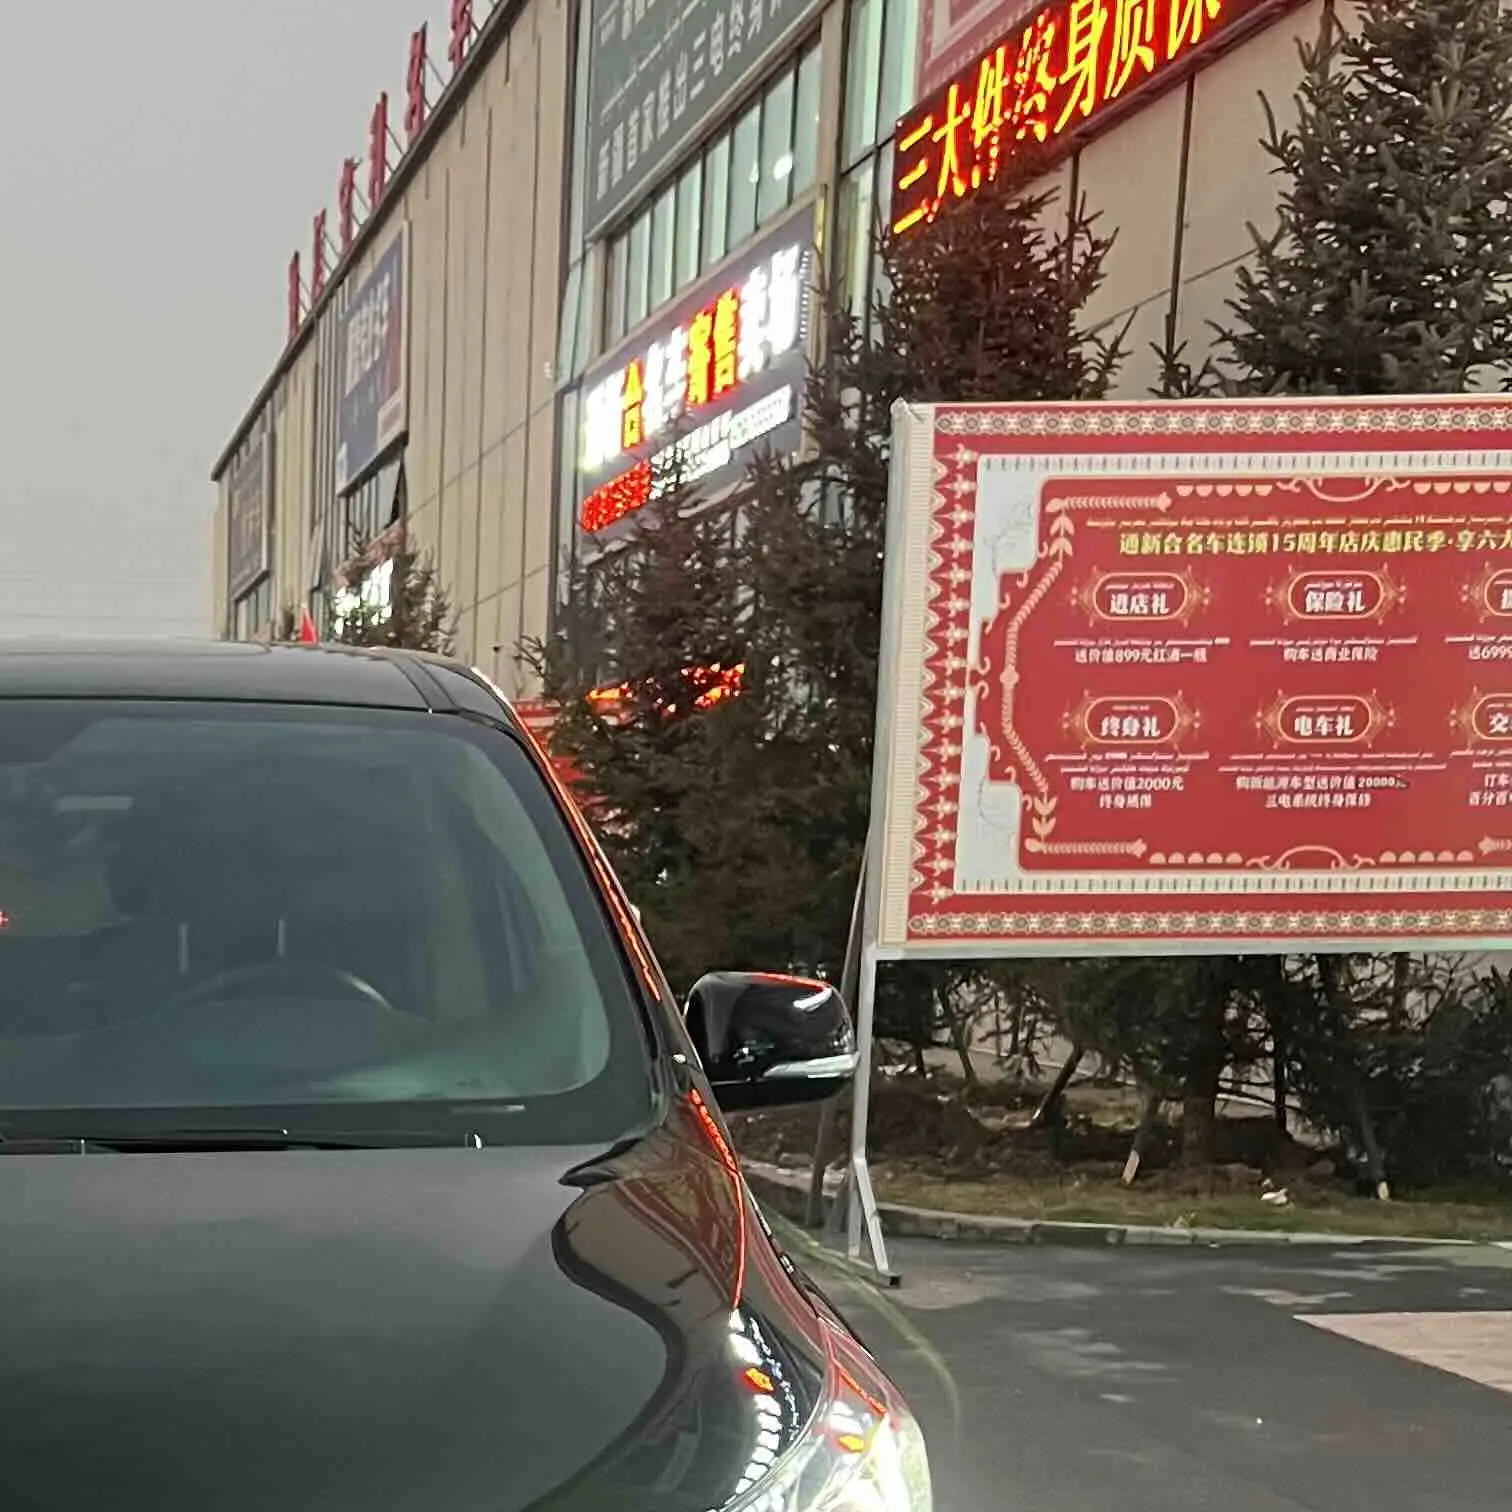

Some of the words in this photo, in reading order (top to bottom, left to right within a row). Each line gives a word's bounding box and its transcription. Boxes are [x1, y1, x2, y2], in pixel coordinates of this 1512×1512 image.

[1305, 590, 1366, 613] 保险礼
[1100, 715, 1161, 737] 终身礼
[1294, 715, 1354, 737] 电车礼
